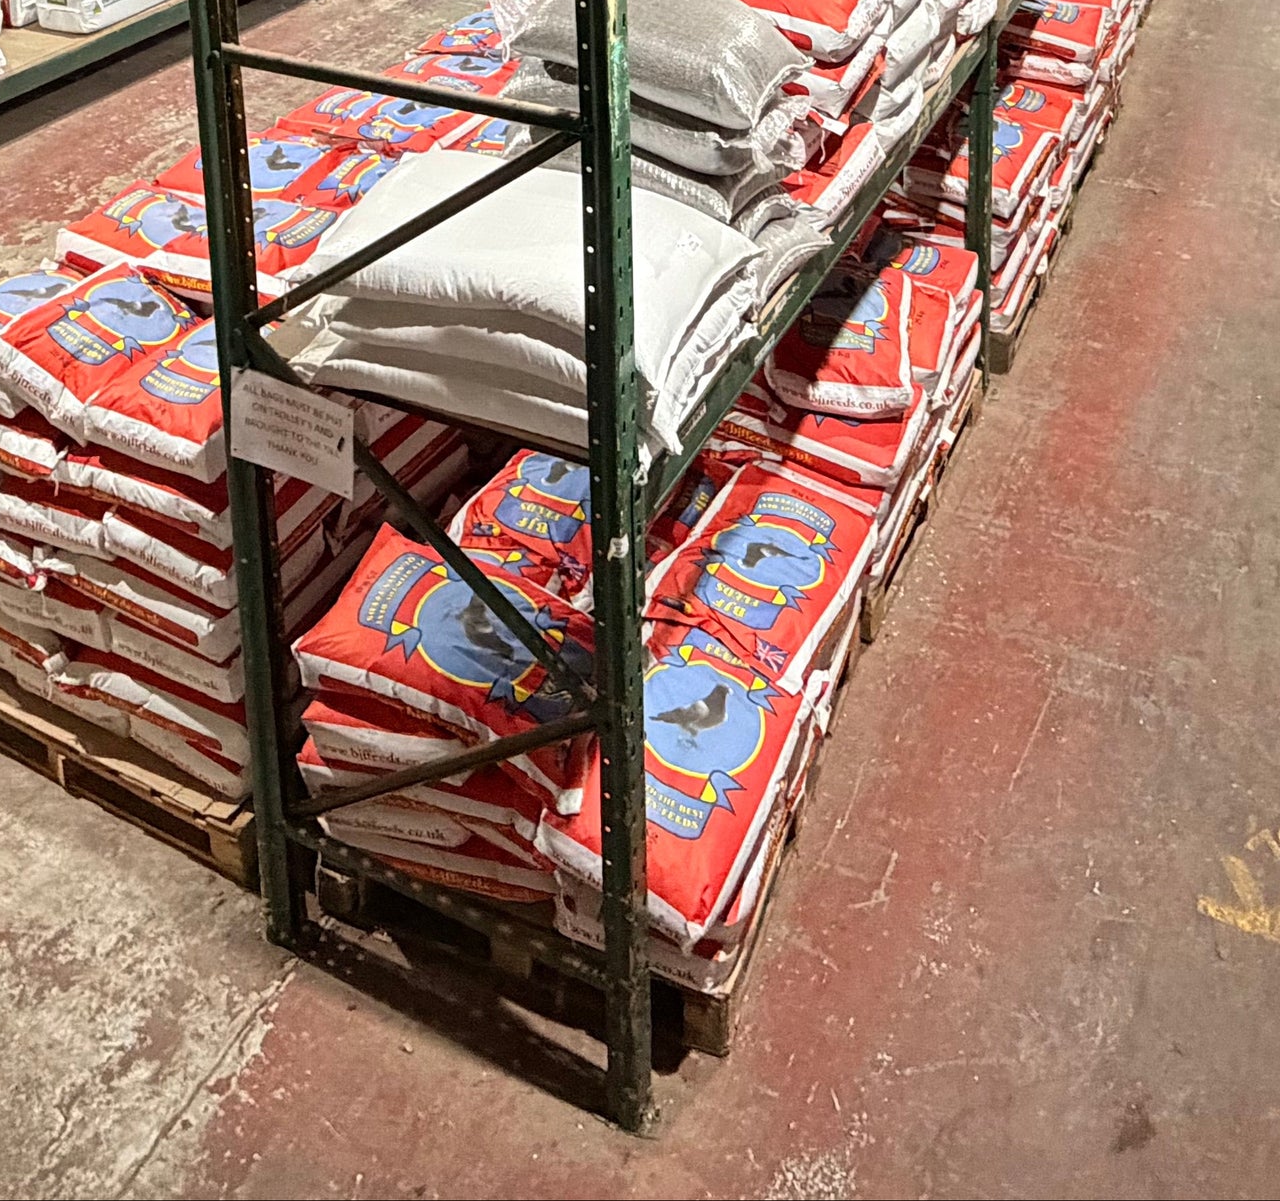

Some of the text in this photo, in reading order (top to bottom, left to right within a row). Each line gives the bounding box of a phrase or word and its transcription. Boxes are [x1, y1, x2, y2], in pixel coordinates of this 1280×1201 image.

[515, 514, 550, 533] BJF
[714, 581, 760, 608] FEEDS
[712, 595, 748, 619] BJF
[657, 795, 675, 806] THE
[677, 803, 704, 819] BEST
[659, 807, 700, 830] FEEDS
